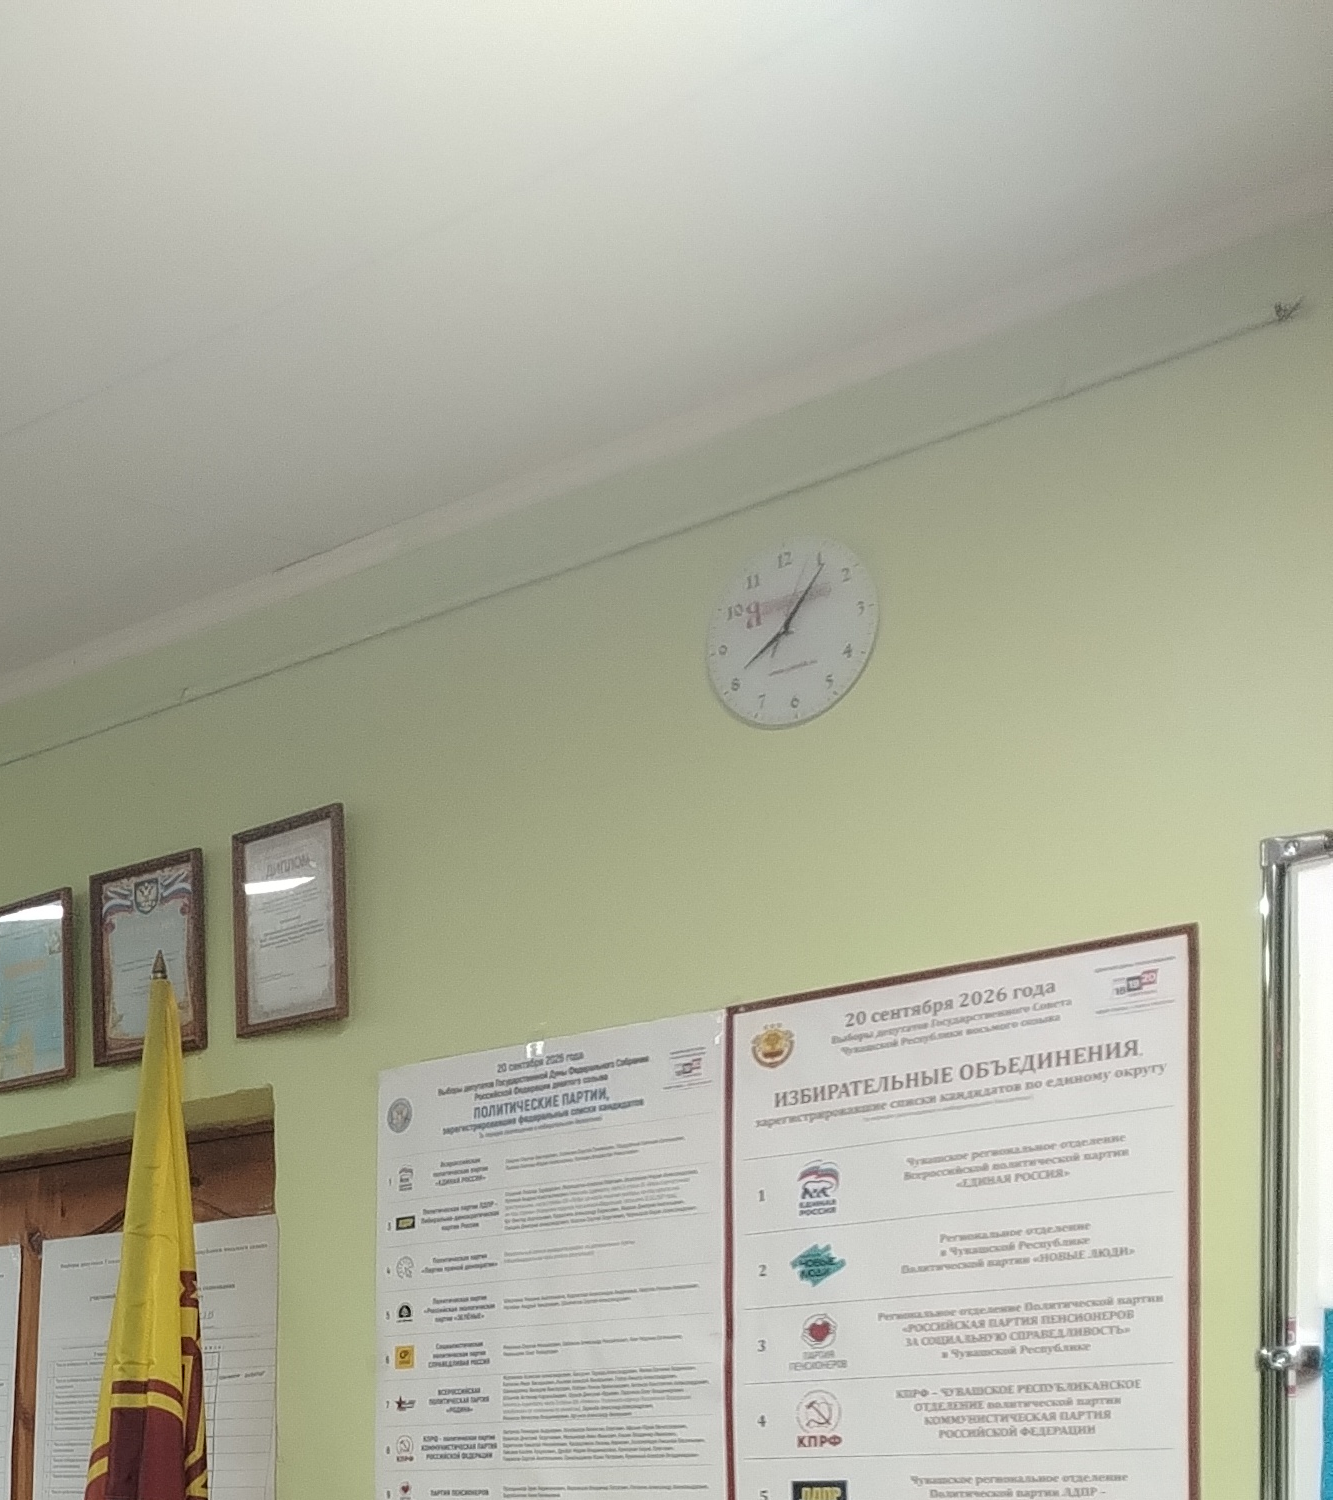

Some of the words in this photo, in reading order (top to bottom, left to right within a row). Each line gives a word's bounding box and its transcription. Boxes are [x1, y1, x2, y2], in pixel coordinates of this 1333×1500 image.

[777, 552, 792, 569] 12
[746, 574, 760, 589] 11
[842, 568, 851, 582] 2
[727, 604, 743, 621] 10
[856, 601, 865, 615] 3
[842, 643, 852, 658] 4
[758, 693, 766, 708] 7
[266, 853, 311, 878] ДИПЛОМ
[845, 1011, 867, 1027] 20
[871, 999, 954, 1023] сентября
[959, 987, 1008, 1009] 2026
[1013, 981, 1056, 1001] года
[831, 1029, 874, 1045] Выборы
[876, 1022, 929, 1039] депутатов
[931, 1005, 1031, 1030] Государственного
[1032, 998, 1073, 1013] Совета
[841, 1039, 899, 1056] Чувашской
[901, 1028, 963, 1047] Республики
[966, 1021, 1018, 1037] восьмого
[1020, 1013, 1061, 1028] созыва
[496, 1063, 507, 1074] 20
[508, 1057, 544, 1072] сентября
[566, 1051, 584, 1062] года
[754, 1101, 886, 1129] зарегистрировавшие
[889, 1094, 937, 1111] списки
[939, 1081, 1022, 1103] кандидатов
[1025, 1078, 1043, 1091] по
[1045, 1069, 1112, 1090] единому
[1114, 1061, 1168, 1080] округу
[774, 1066, 954, 1109] ИЗБИРАТЕЛЬНЫЕ
[473, 1094, 560, 1119] ПОЛИТИЧЕСКИЕ
[562, 1087, 610, 1107] ПАРТИИ,
[906, 1149, 969, 1168] Чувашское
[971, 1141, 1058, 1161] региональное
[1060, 1133, 1126, 1149] отделение
[903, 1161, 989, 1181] Всероссийской
[991, 1152, 1080, 1172] политической
[1083, 1148, 1130, 1164] партии
[759, 1189, 766, 1202] 1
[939, 1226, 1023, 1244] Региональное
[1026, 1222, 1091, 1237] отделение
[949, 1241, 1016, 1258] Чувашской
[1018, 1236, 1091, 1253] Республике
[758, 1264, 767, 1277] 2
[900, 1258, 985, 1275] Политической
[987, 1255, 1031, 1271] партии
[877, 1307, 957, 1322] Региональное
[959, 1303, 1022, 1318] отделение
[1024, 1296, 1114, 1313] Политической
[1117, 1294, 1164, 1308] партии
[988, 1315, 1039, 1329] ПАРТИЯ
[1041, 1309, 1134, 1326] ПЕНСИОНЕРОВ
[757, 1339, 766, 1352] 3
[950, 1345, 1017, 1360] Чувашской
[1020, 1342, 1091, 1357] Республике
[941, 1384, 1015, 1398] ЧУВАШСКОЕ
[1017, 1379, 1141, 1395] РЕСПУБЛИКАНСКОЕ
[913, 1400, 984, 1413] ОТДЕЛЕНИЕ
[987, 1396, 1074, 1410] политической
[1076, 1396, 1121, 1409] партии
[757, 1415, 767, 1428] 4
[924, 1411, 1057, 1426] КОММУНИСТИЧЕСКАЯ
[1059, 1410, 1112, 1422] ПАРТИЯ
[1020, 1424, 1096, 1438] ФЕДЕРАЦИИ
[796, 1434, 843, 1448] КПРФ
[910, 1475, 973, 1488] Чувашское
[975, 1473, 1059, 1487] региональное
[1061, 1472, 1128, 1484] отделение
[929, 1487, 1013, 1499] Политической
[1016, 1488, 1059, 1500] партии
